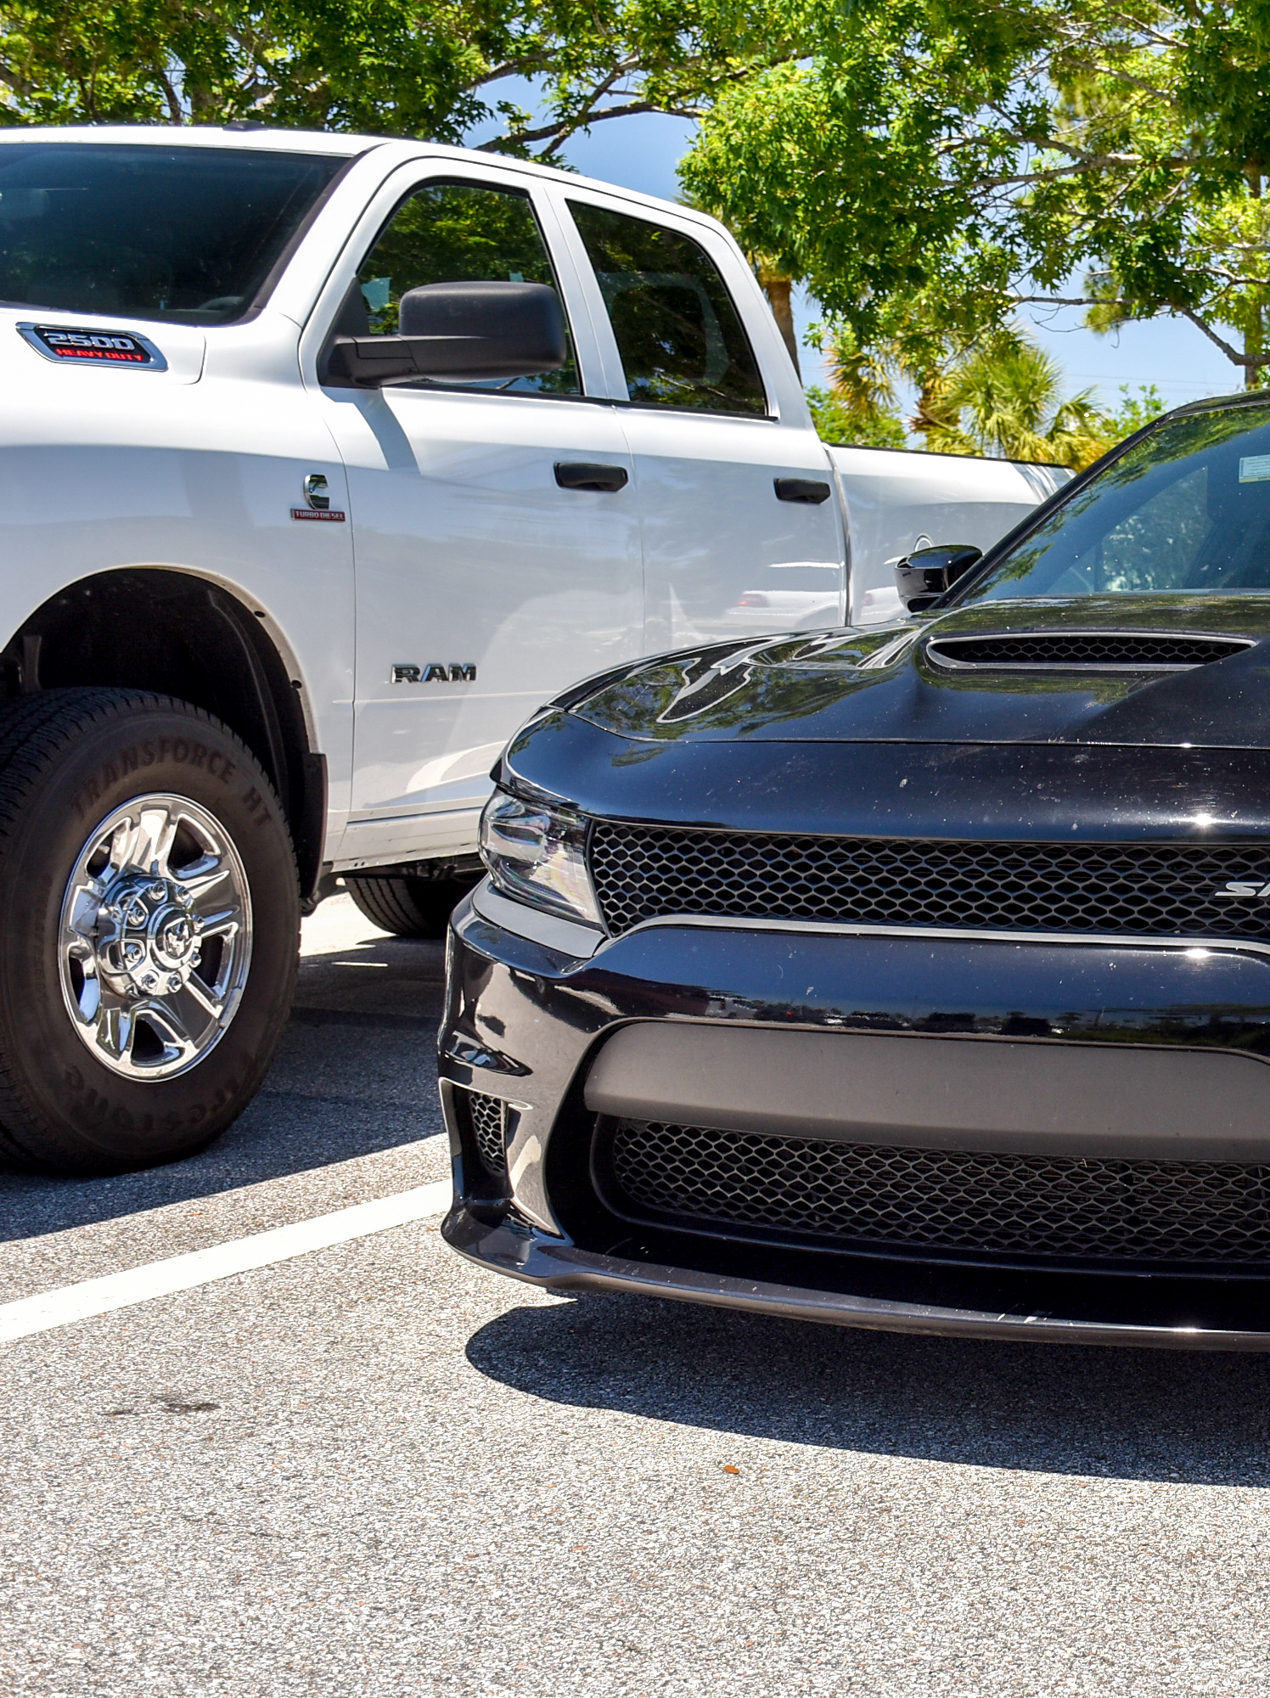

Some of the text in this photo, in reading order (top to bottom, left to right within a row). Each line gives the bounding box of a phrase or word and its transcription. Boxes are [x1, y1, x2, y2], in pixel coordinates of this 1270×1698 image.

[43, 331, 136, 350] 2500
[56, 348, 144, 361] HEAVY DUTY
[295, 511, 343, 520] TURBO DIESEL
[391, 663, 477, 684] RAM
[70, 736, 272, 827] TRANSFORCE HT
